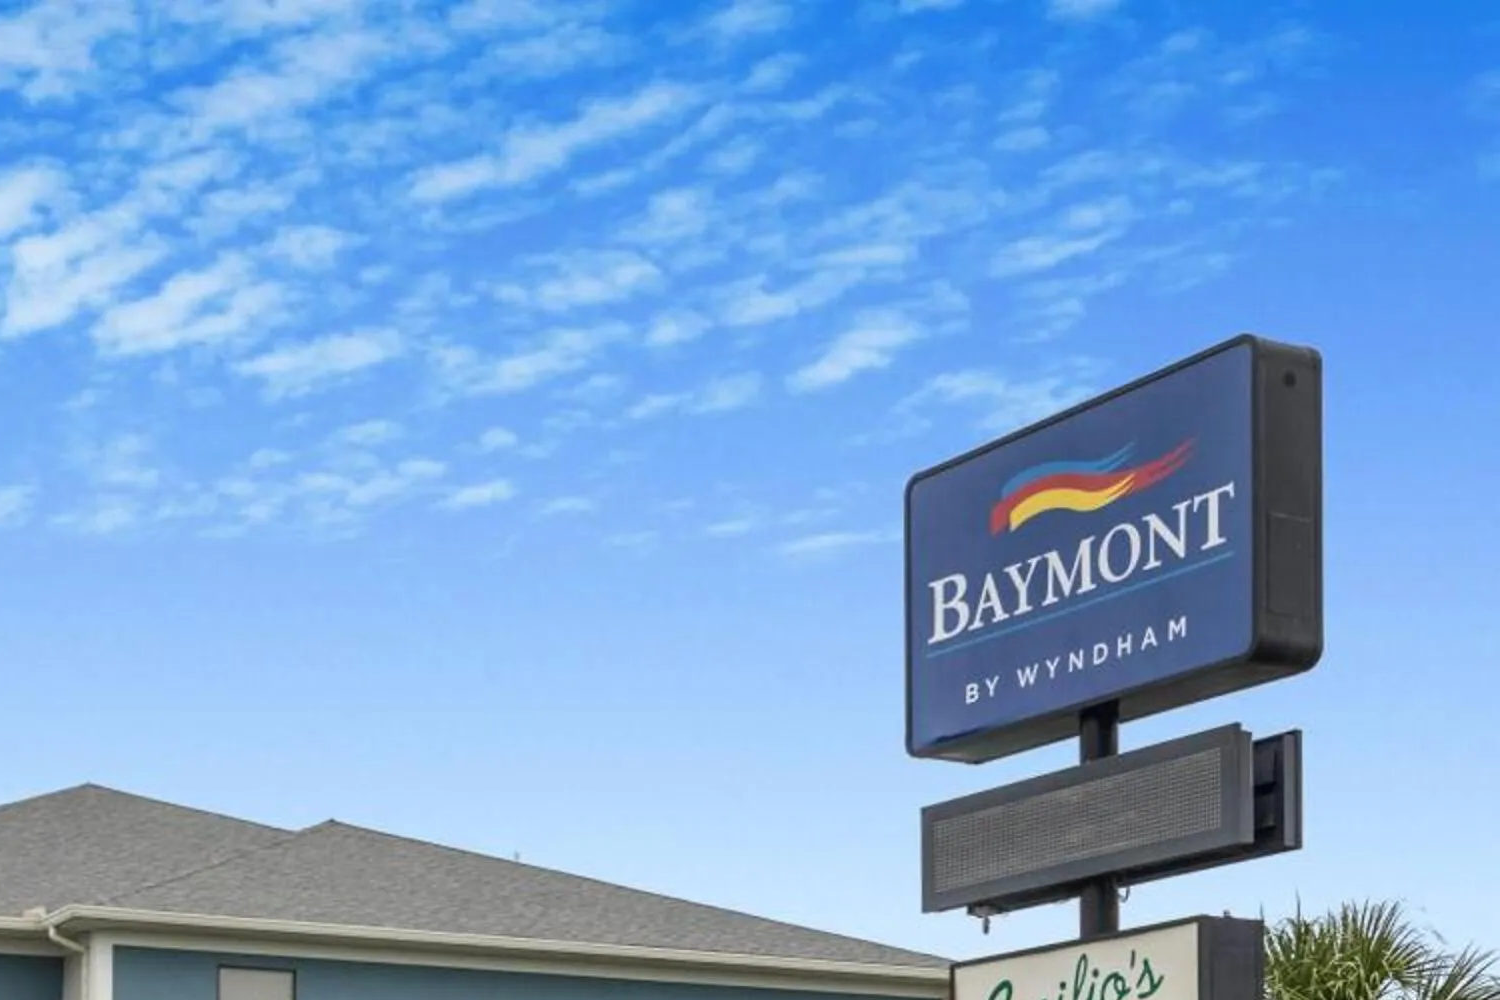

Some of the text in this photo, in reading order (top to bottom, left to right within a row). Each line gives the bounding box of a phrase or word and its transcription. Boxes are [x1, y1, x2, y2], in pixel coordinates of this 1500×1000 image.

[928, 482, 1235, 645] BAYMONT
[964, 616, 1188, 705] BY WYNDHAM
